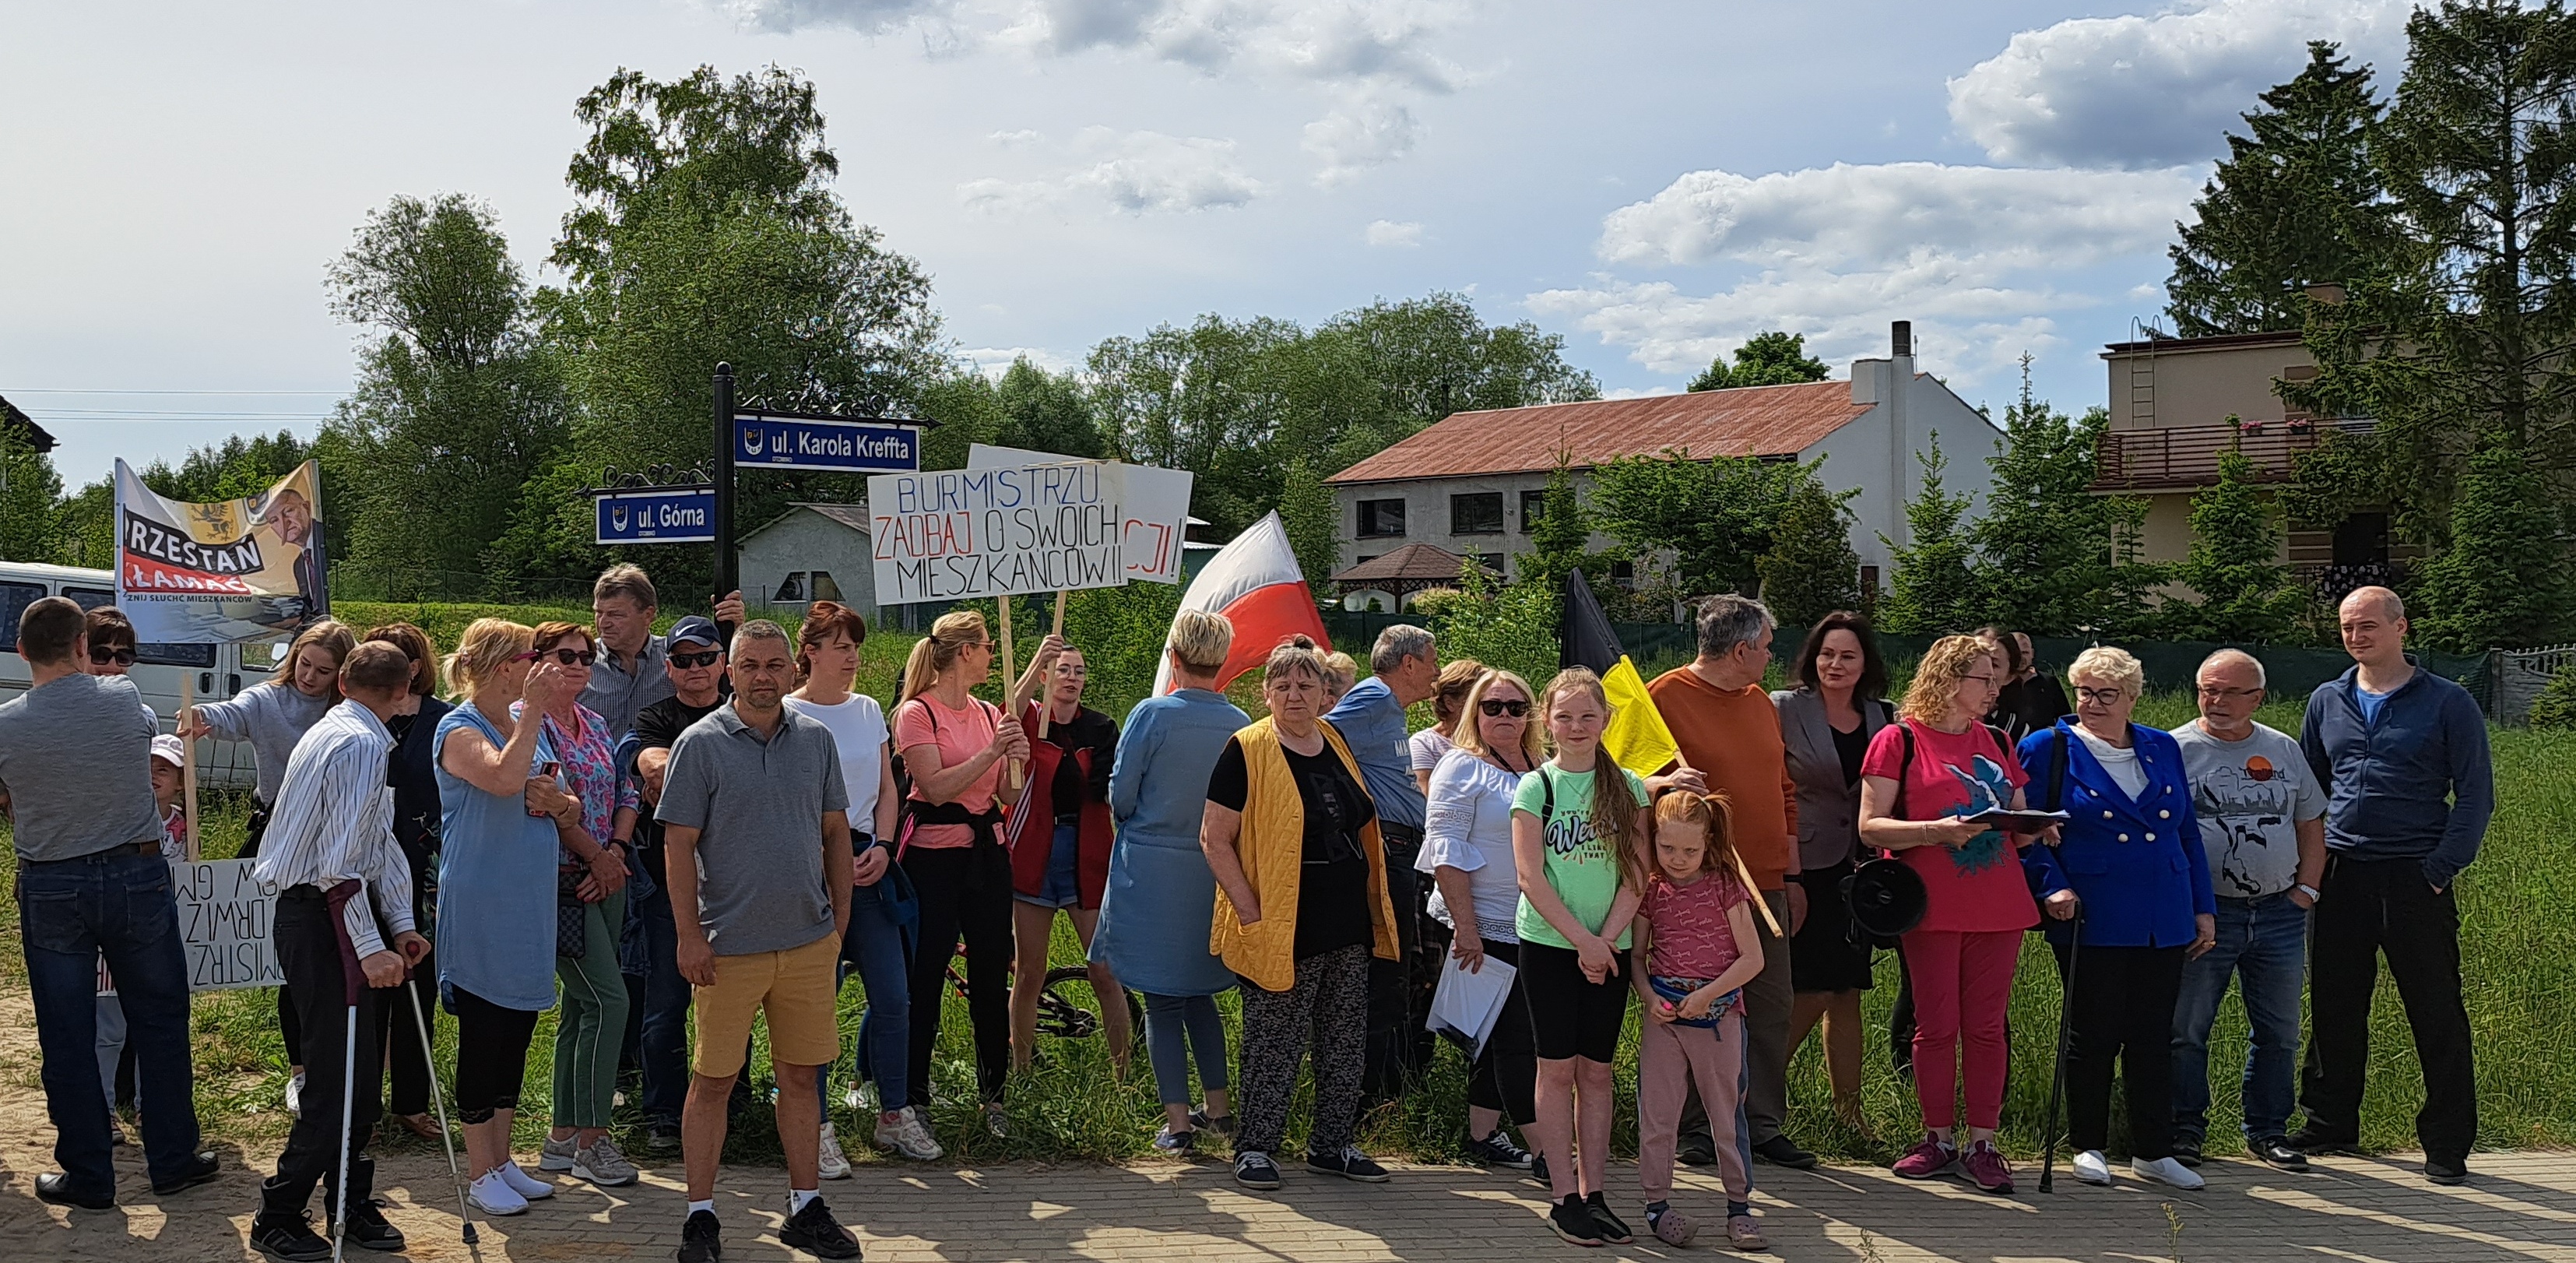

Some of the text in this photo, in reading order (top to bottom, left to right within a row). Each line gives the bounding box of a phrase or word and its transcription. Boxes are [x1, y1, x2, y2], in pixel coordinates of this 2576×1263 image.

[772, 431, 909, 459] ul. Karola Kreffta
[638, 504, 705, 528] ul. Górna
[875, 504, 1117, 560] ZADBAJ O SWOICH
[125, 516, 261, 572] RZESTAŃ
[125, 562, 248, 592] ŁAMAĆ
[172, 864, 213, 902] GM
